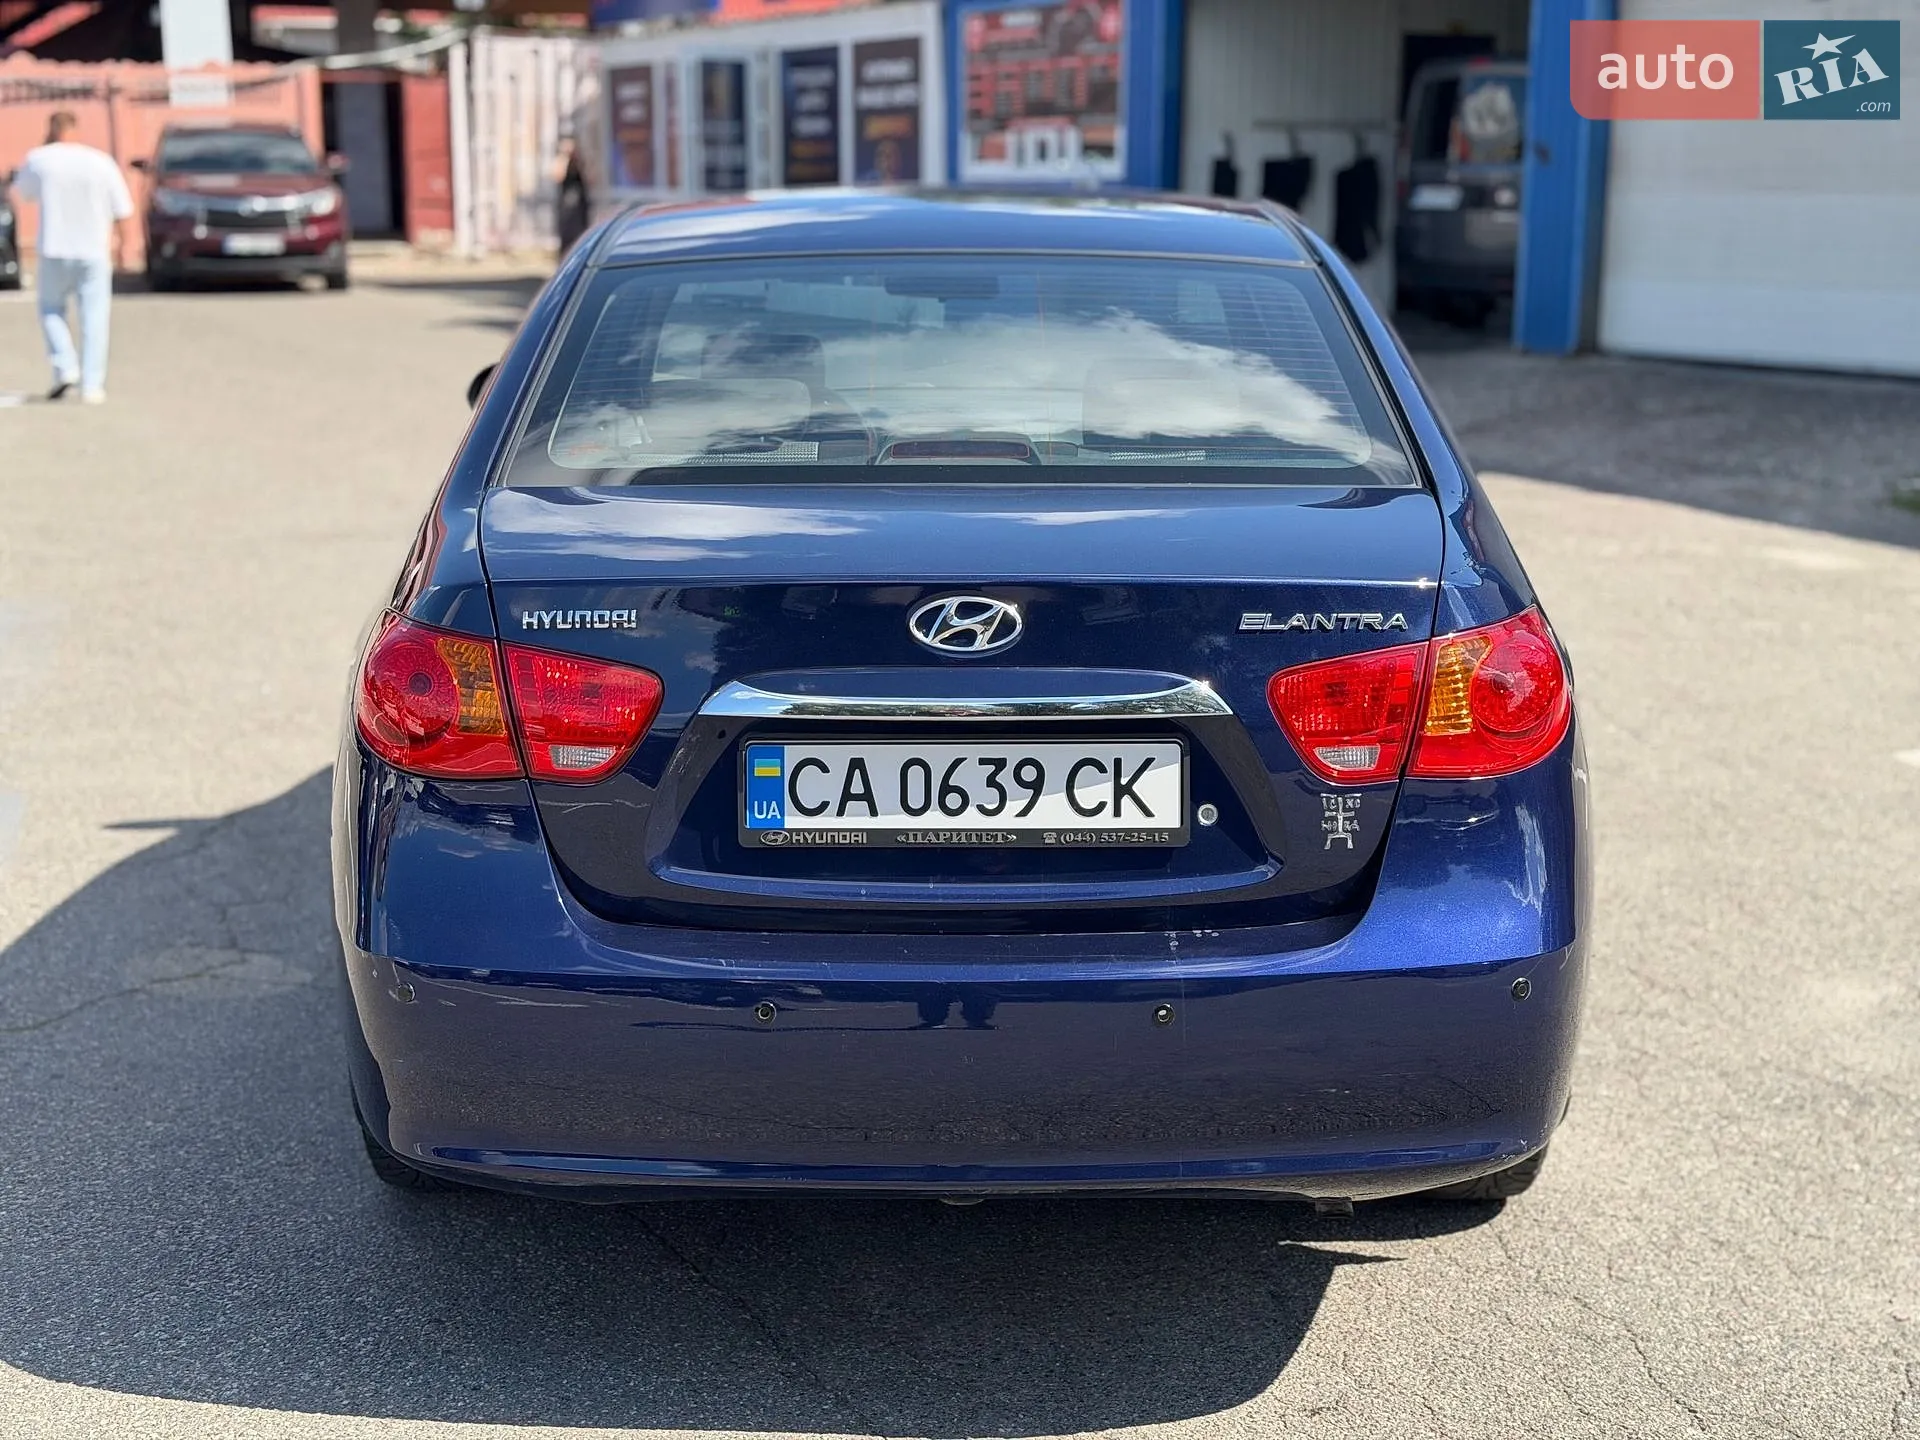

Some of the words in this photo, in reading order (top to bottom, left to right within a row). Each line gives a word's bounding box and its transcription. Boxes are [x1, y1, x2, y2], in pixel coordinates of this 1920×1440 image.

[522, 609, 637, 629] HYUNDAI
[1238, 613, 1409, 631] ELANTRA
[788, 757, 879, 817] CA
[899, 757, 1046, 817] 0639
[1065, 757, 1156, 817] CK
[754, 800, 781, 819] UA
[792, 831, 867, 844] HYUNDAI
